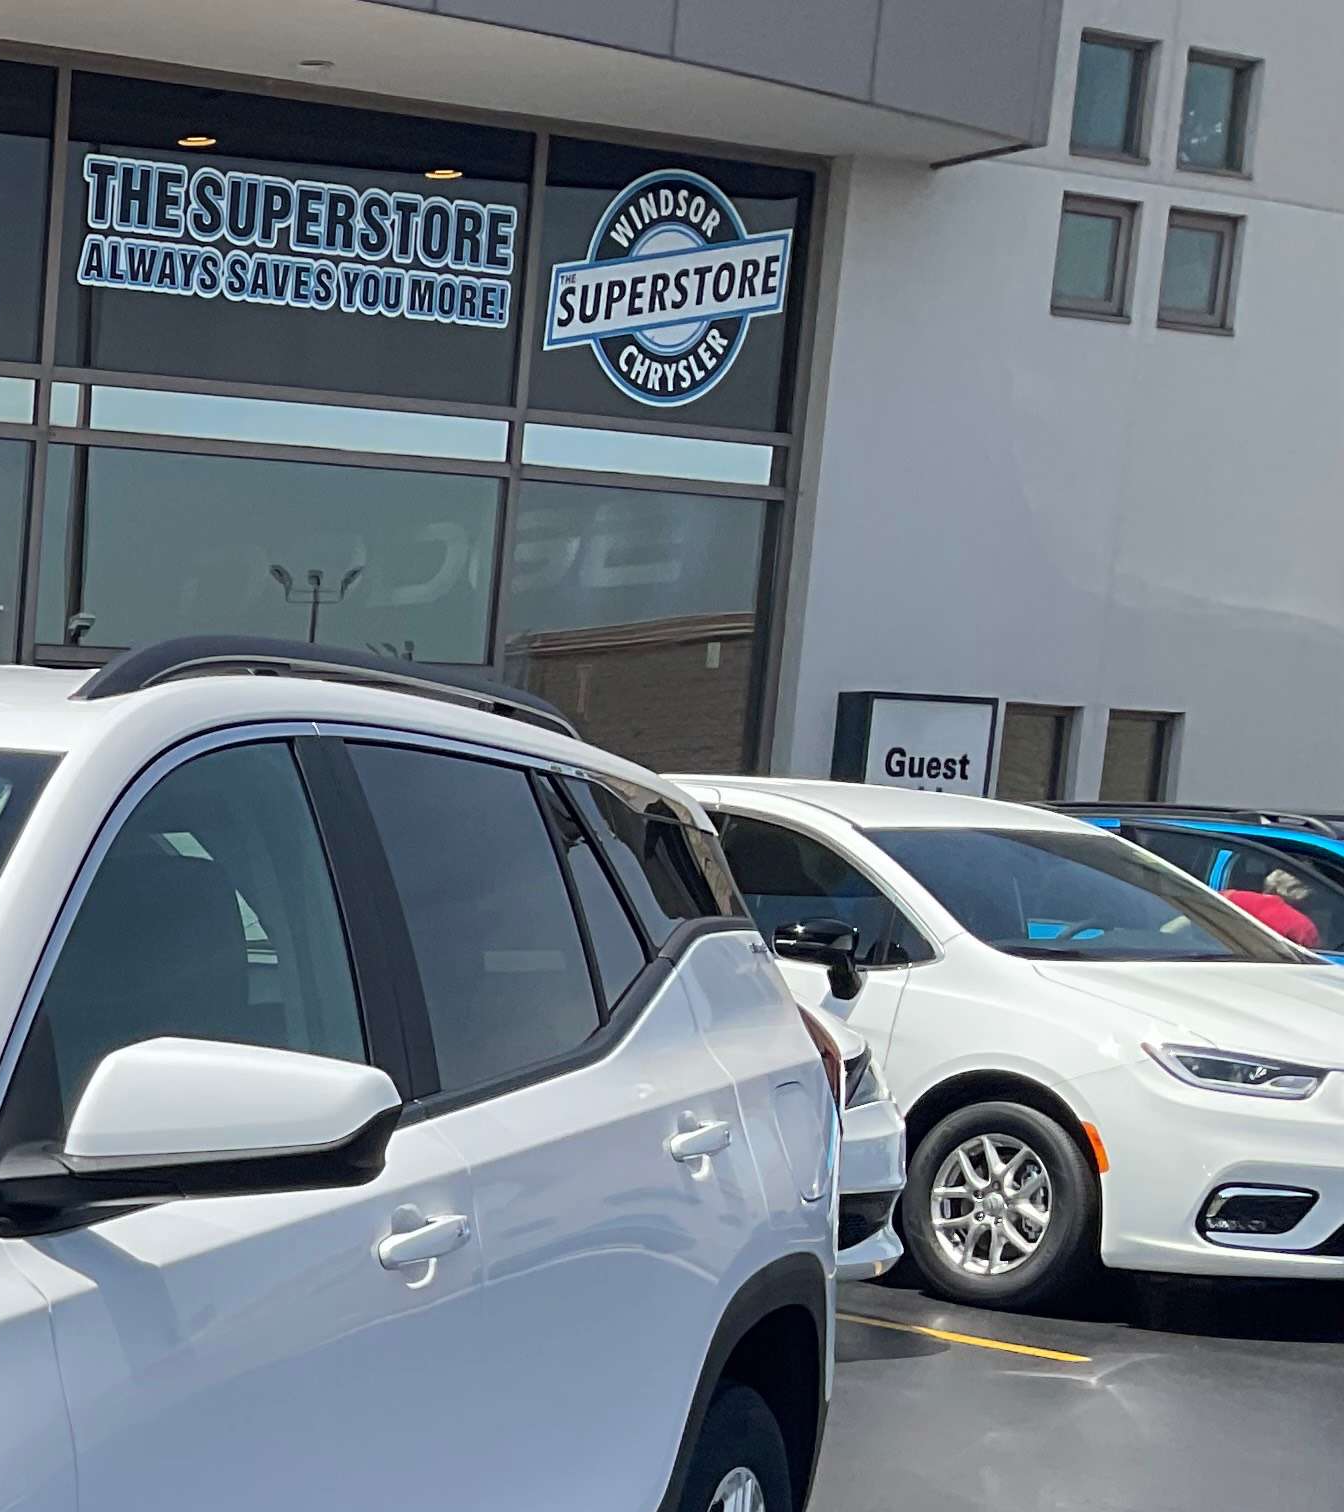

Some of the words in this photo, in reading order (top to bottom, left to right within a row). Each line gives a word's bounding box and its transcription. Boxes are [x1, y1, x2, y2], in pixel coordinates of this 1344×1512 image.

[89, 162, 183, 229] THE
[192, 171, 512, 268] SUPERSTORE
[610, 188, 721, 248] WINDSOR
[83, 242, 219, 294] ALWAYS
[228, 256, 333, 303] SAVES
[344, 270, 402, 313] YOU
[409, 277, 507, 321] MORE!
[556, 254, 780, 328] SUPERSTORE
[560, 273, 577, 285] THE
[618, 327, 729, 392] CHRYSLER
[885, 747, 970, 780] Guest
